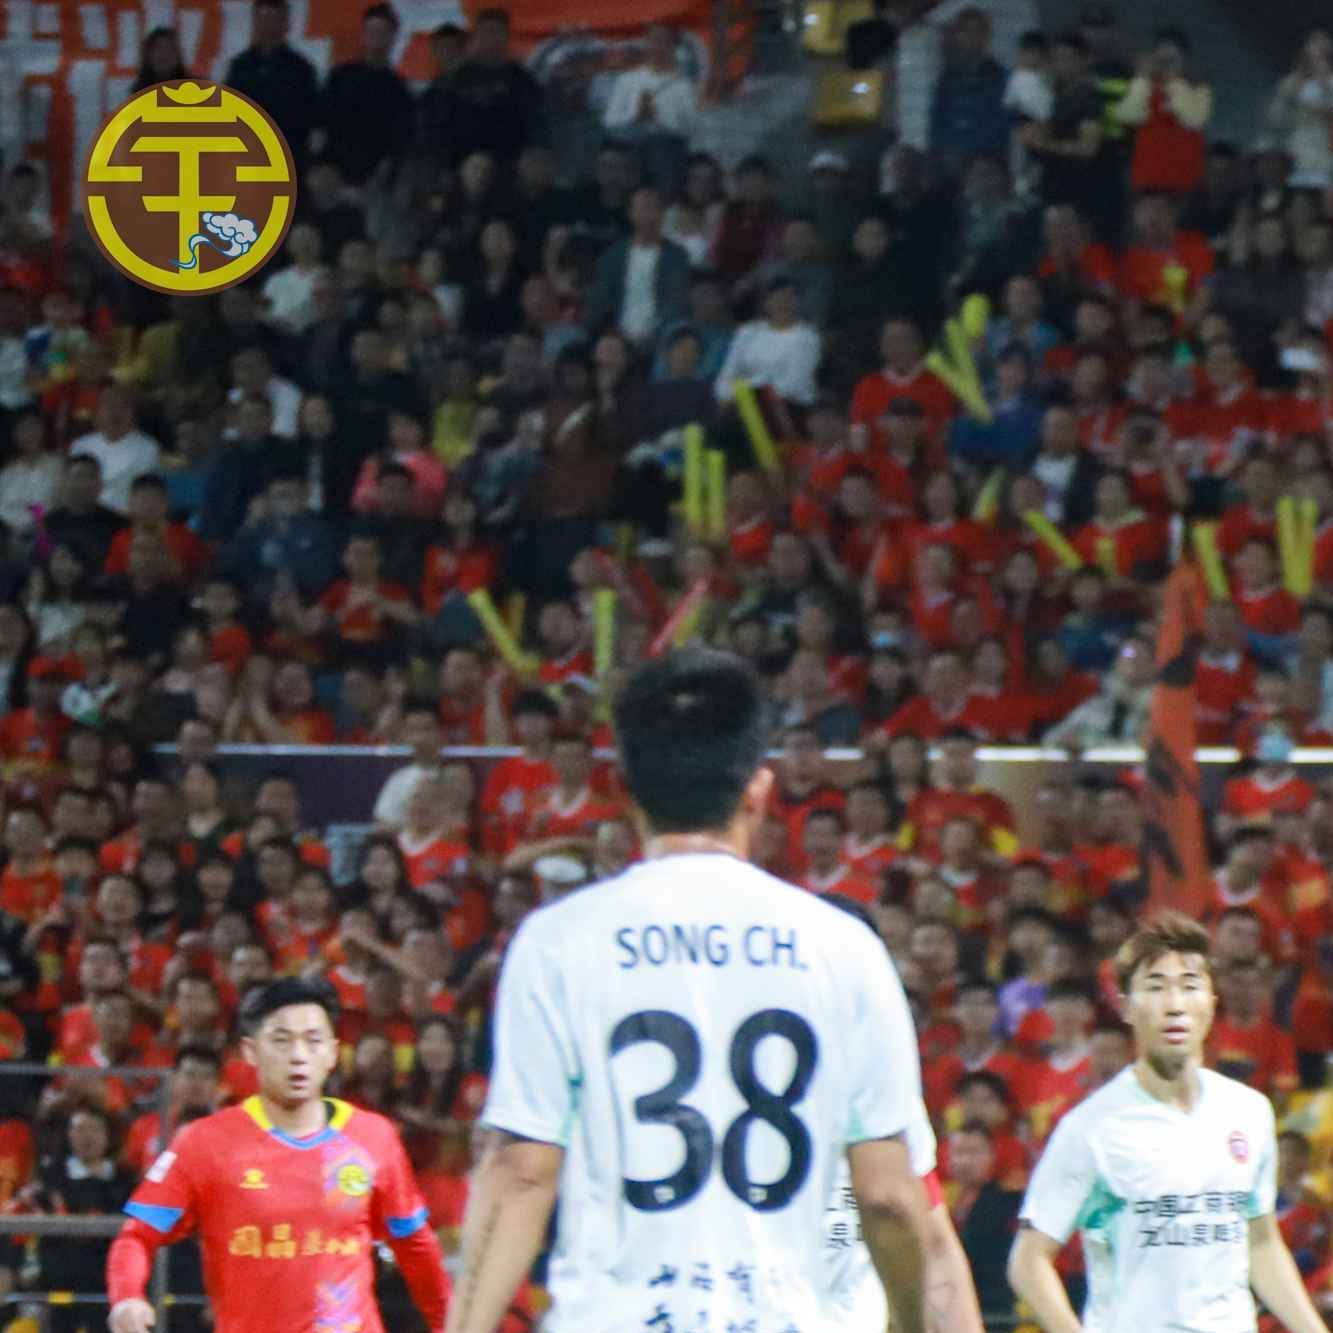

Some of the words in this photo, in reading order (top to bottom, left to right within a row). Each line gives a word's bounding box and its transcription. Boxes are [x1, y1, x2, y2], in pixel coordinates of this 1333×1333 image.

[616, 924, 731, 970] SONG
[743, 925, 810, 971] CH.
[608, 1008, 819, 1214] 38
